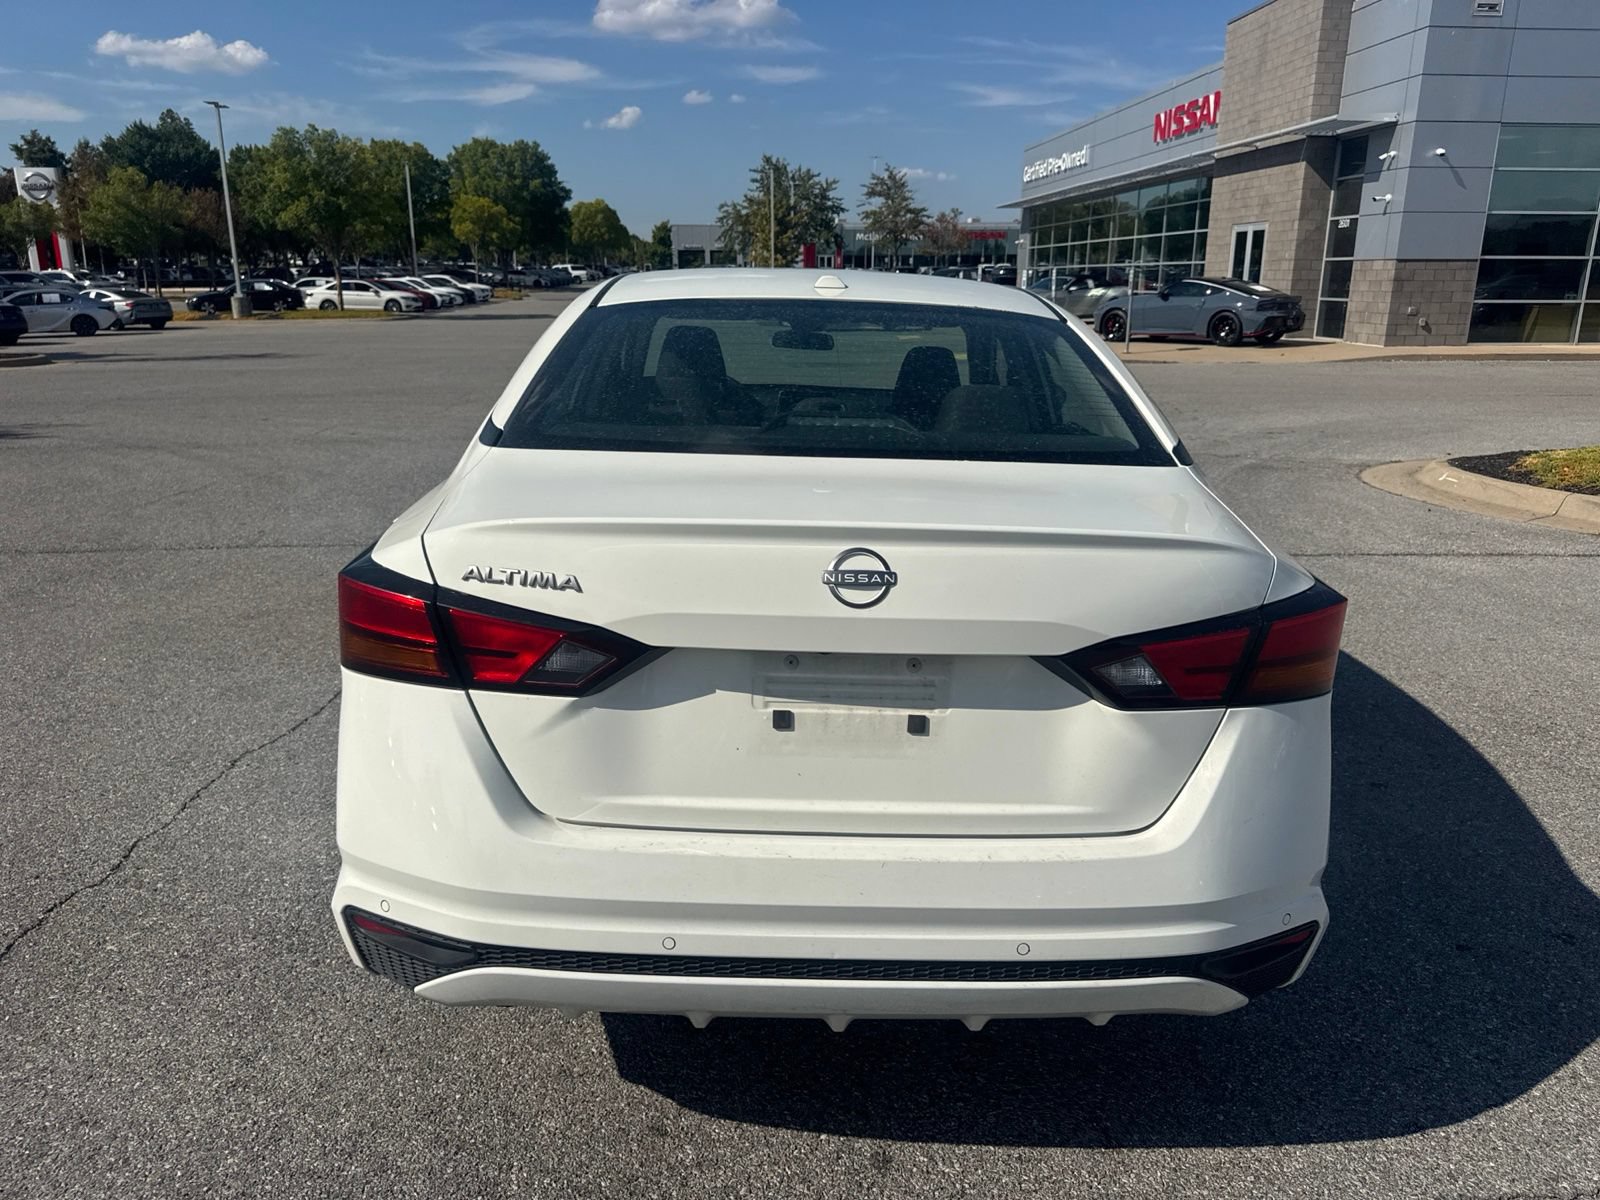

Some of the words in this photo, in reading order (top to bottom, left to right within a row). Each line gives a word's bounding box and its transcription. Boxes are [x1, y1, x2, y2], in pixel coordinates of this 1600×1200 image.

[1023, 160, 1048, 182] Certified
[1048, 145, 1087, 175] Pre-Owned
[461, 564, 584, 594] ALTIMA
[823, 572, 896, 583] NISSAN
